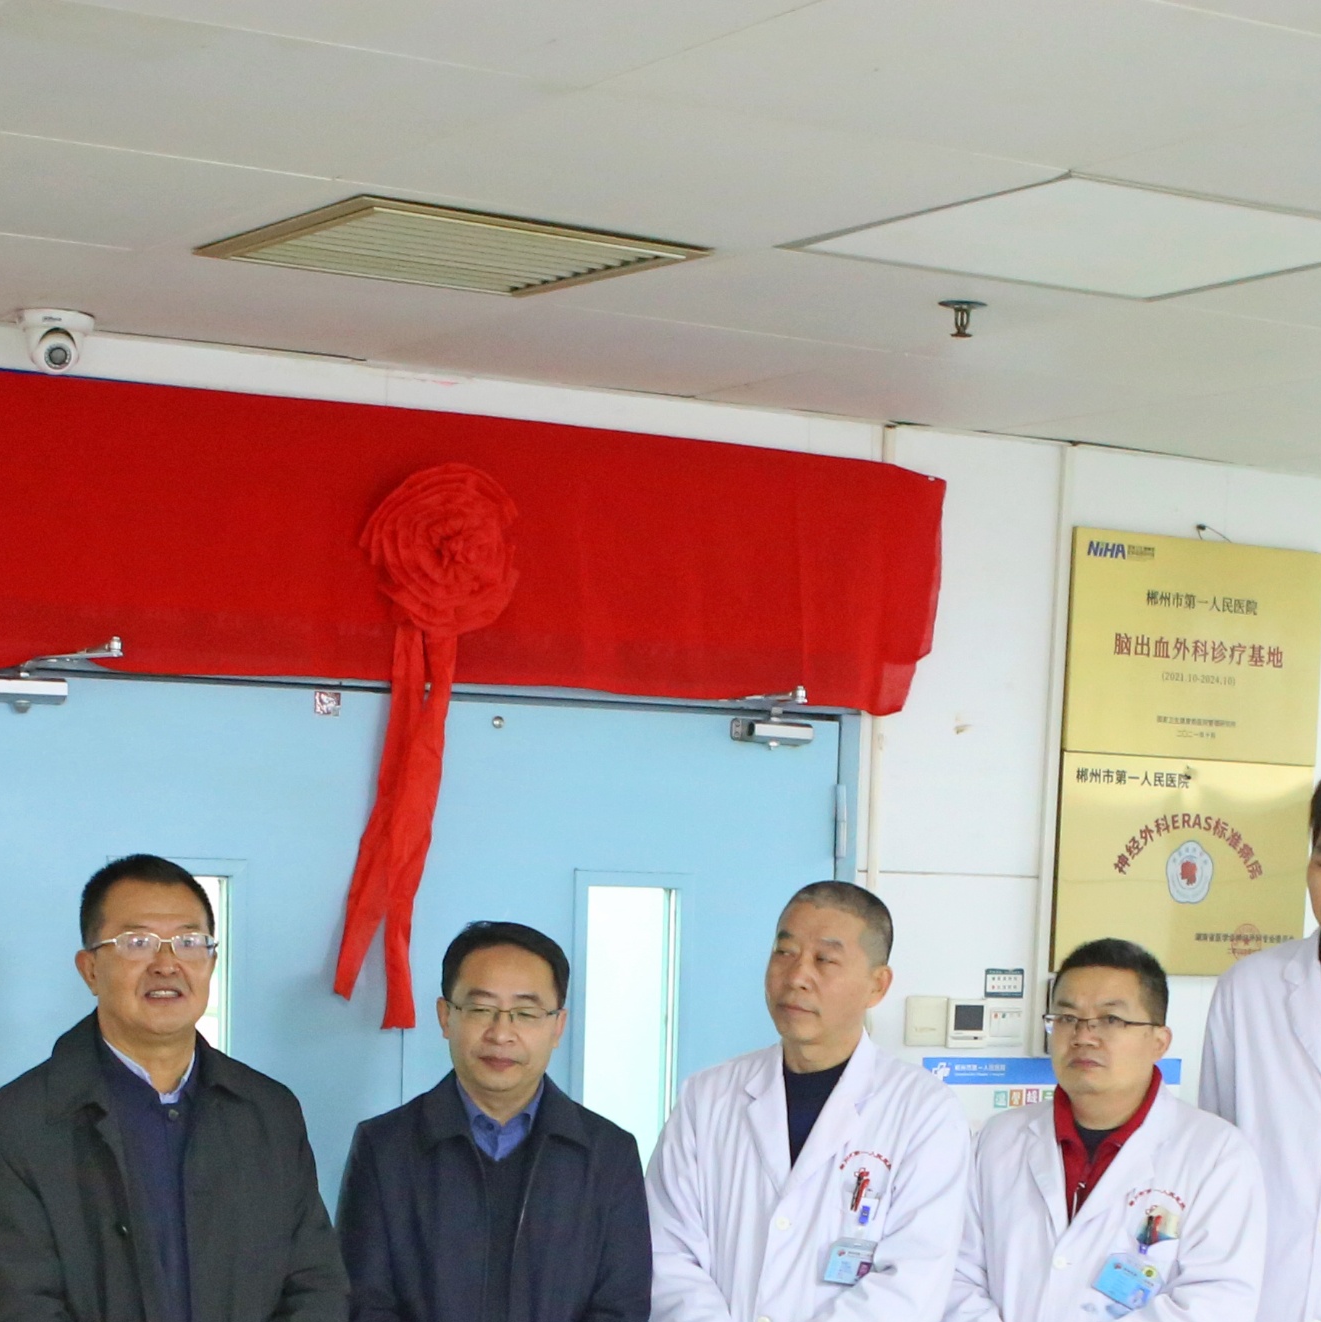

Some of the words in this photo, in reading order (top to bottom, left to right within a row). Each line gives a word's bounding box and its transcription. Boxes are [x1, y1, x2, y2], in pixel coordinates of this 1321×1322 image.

[1146, 589, 1258, 616] 郴州市第一人民医院
[1113, 632, 1284, 669] 脑出血外科诊疗基地
[1161, 671, 1236, 687] (2021.10-2024.10)
[1076, 767, 1191, 789] 郴州市第一人民医院
[1113, 812, 1264, 881] 神经外科ERAS标准病房
